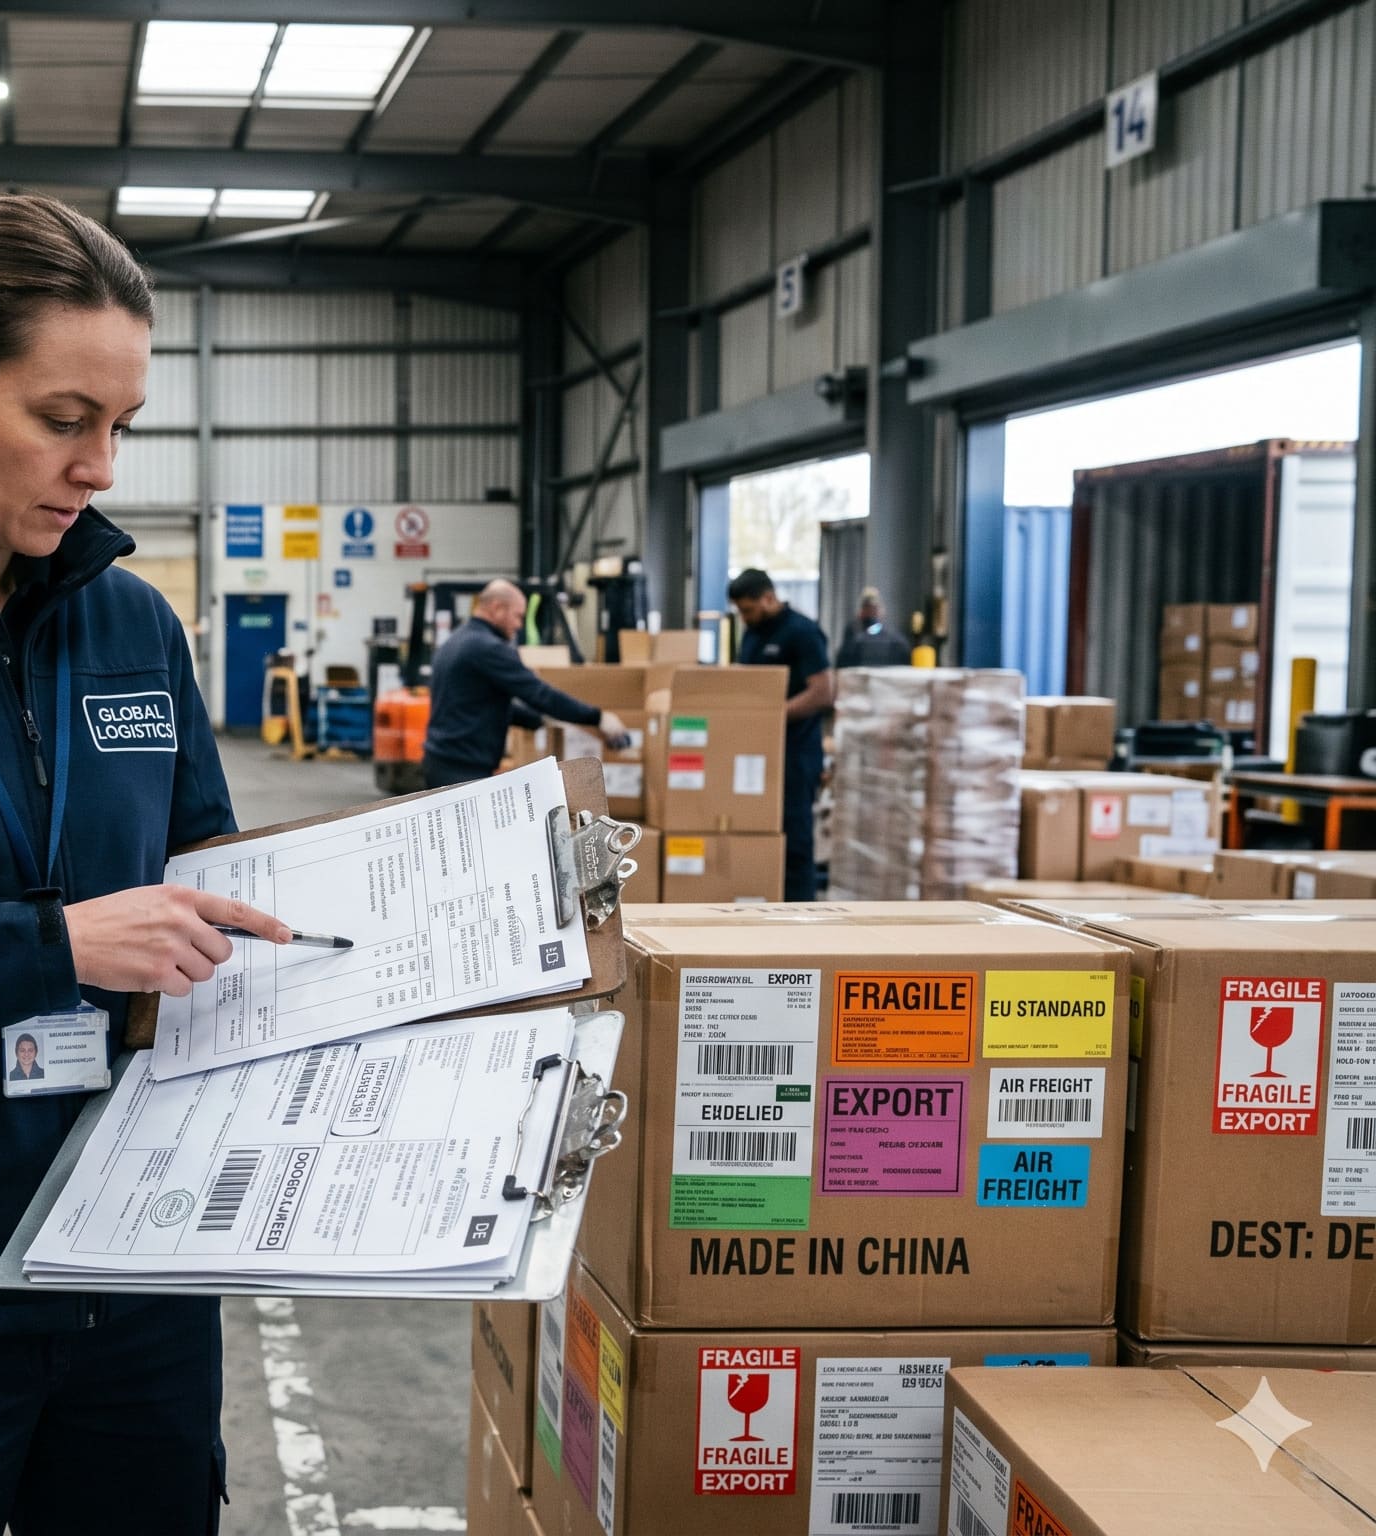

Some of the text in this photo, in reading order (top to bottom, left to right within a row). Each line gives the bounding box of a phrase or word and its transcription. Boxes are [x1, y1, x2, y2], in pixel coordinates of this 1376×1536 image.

[1113, 86, 1146, 152] 14
[98, 703, 165, 722] GLOBAL
[95, 722, 173, 740] LOGISTICS
[768, 973, 813, 985] EXPORT
[844, 981, 967, 1011] FRAGILE
[1225, 980, 1321, 999] FRAGILE
[990, 1000, 1106, 1017] EU STANDARD
[999, 1078, 1093, 1093] AIR FREIGHT
[1222, 1083, 1312, 1104] FRAGILE
[832, 1087, 954, 1117] EXPORT
[1220, 1112, 1311, 1131] EXPORT
[1013, 1151, 1053, 1173] AIR
[983, 1178, 1083, 1201] FREIGHT
[472, 1222, 490, 1240] DE
[1209, 1220, 1376, 1260] DEST: DE
[689, 1237, 970, 1275] MADE IN CHINA
[702, 1349, 797, 1367] FRAGILE
[703, 1447, 789, 1465] FRAGILE
[702, 1473, 790, 1491] EXPORT
